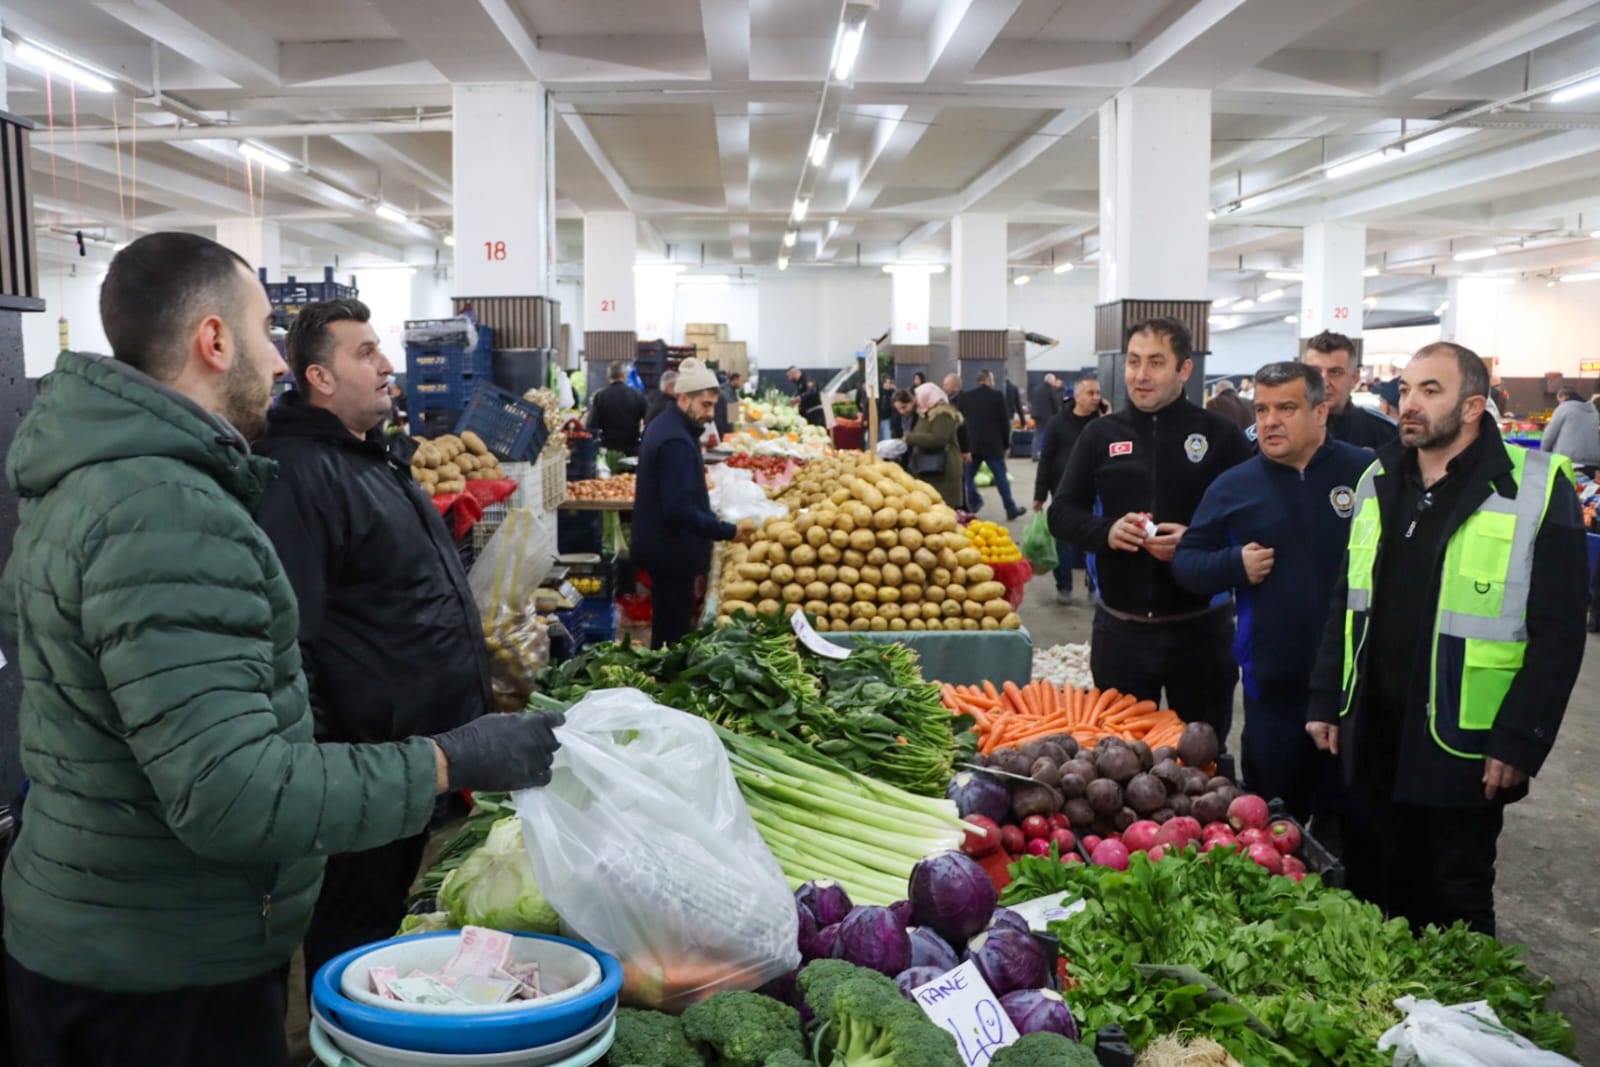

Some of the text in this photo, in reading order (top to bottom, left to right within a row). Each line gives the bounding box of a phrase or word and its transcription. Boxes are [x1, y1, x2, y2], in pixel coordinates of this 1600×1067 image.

[484, 241, 507, 261] 18
[601, 300, 616, 312] 21
[1334, 306, 1349, 319] 20
[917, 969, 969, 1006] TANE
[947, 999, 1006, 1066] 40
